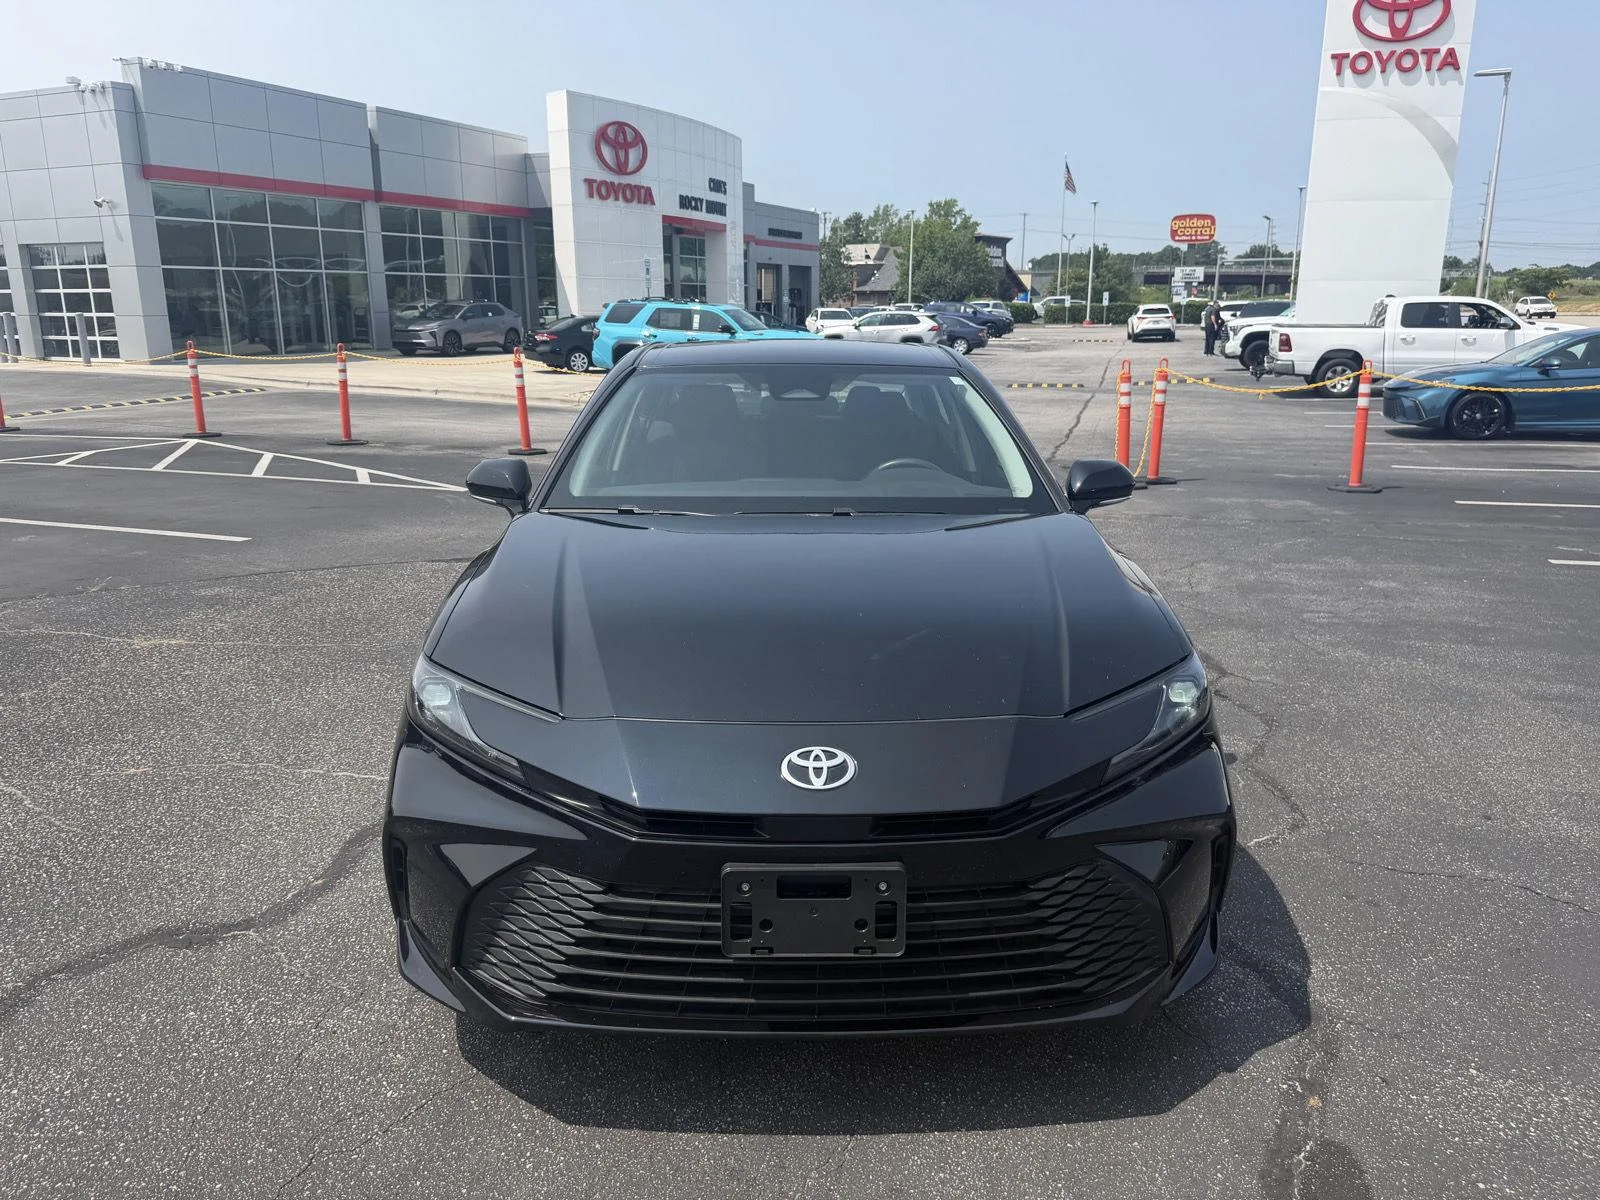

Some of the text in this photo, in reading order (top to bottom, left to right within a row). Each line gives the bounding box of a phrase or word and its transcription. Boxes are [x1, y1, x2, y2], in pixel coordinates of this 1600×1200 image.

[1330, 47, 1461, 76] TOYOTA
[584, 178, 656, 206] TOYOTA
[678, 194, 704, 212] ROCKY
[1172, 218, 1211, 230] golden
[1177, 226, 1215, 236] corral
